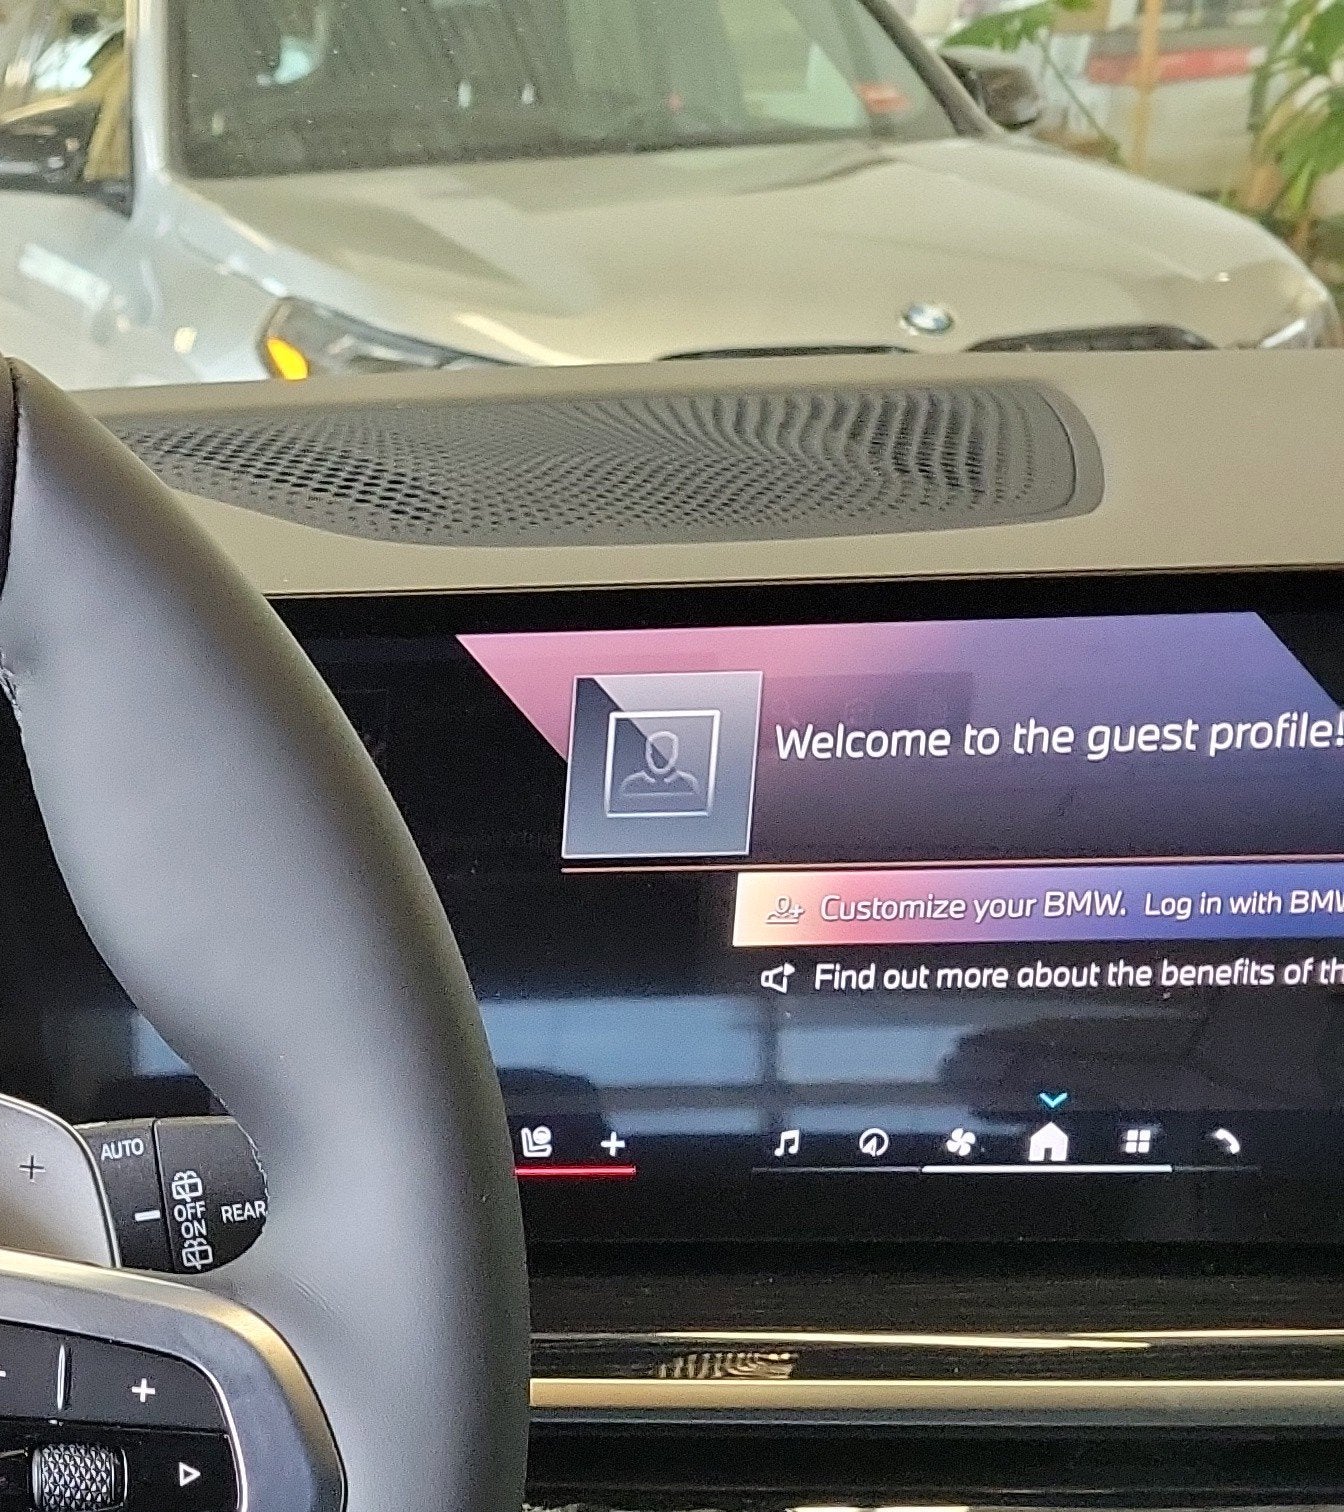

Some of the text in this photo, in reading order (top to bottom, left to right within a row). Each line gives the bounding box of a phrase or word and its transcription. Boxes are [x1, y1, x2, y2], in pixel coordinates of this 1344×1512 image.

[775, 711, 1344, 762] Welcome to the guest profile!
[820, 893, 967, 921] Customize
[974, 897, 1038, 923] your
[1044, 890, 1127, 917] BMW.
[1145, 892, 1193, 920] Log
[1200, 892, 1223, 916] in
[1229, 890, 1282, 915] with
[814, 963, 876, 990] Find
[883, 964, 930, 990] out
[937, 966, 1010, 990] more
[1017, 960, 1100, 989] about
[1107, 959, 1153, 987] the
[1161, 958, 1275, 987] benefits
[1283, 957, 1316, 985] of
[100, 1138, 145, 1161] AUTO
[173, 1201, 207, 1223] OFF
[220, 1200, 268, 1224] REAR
[181, 1220, 208, 1240] ON
